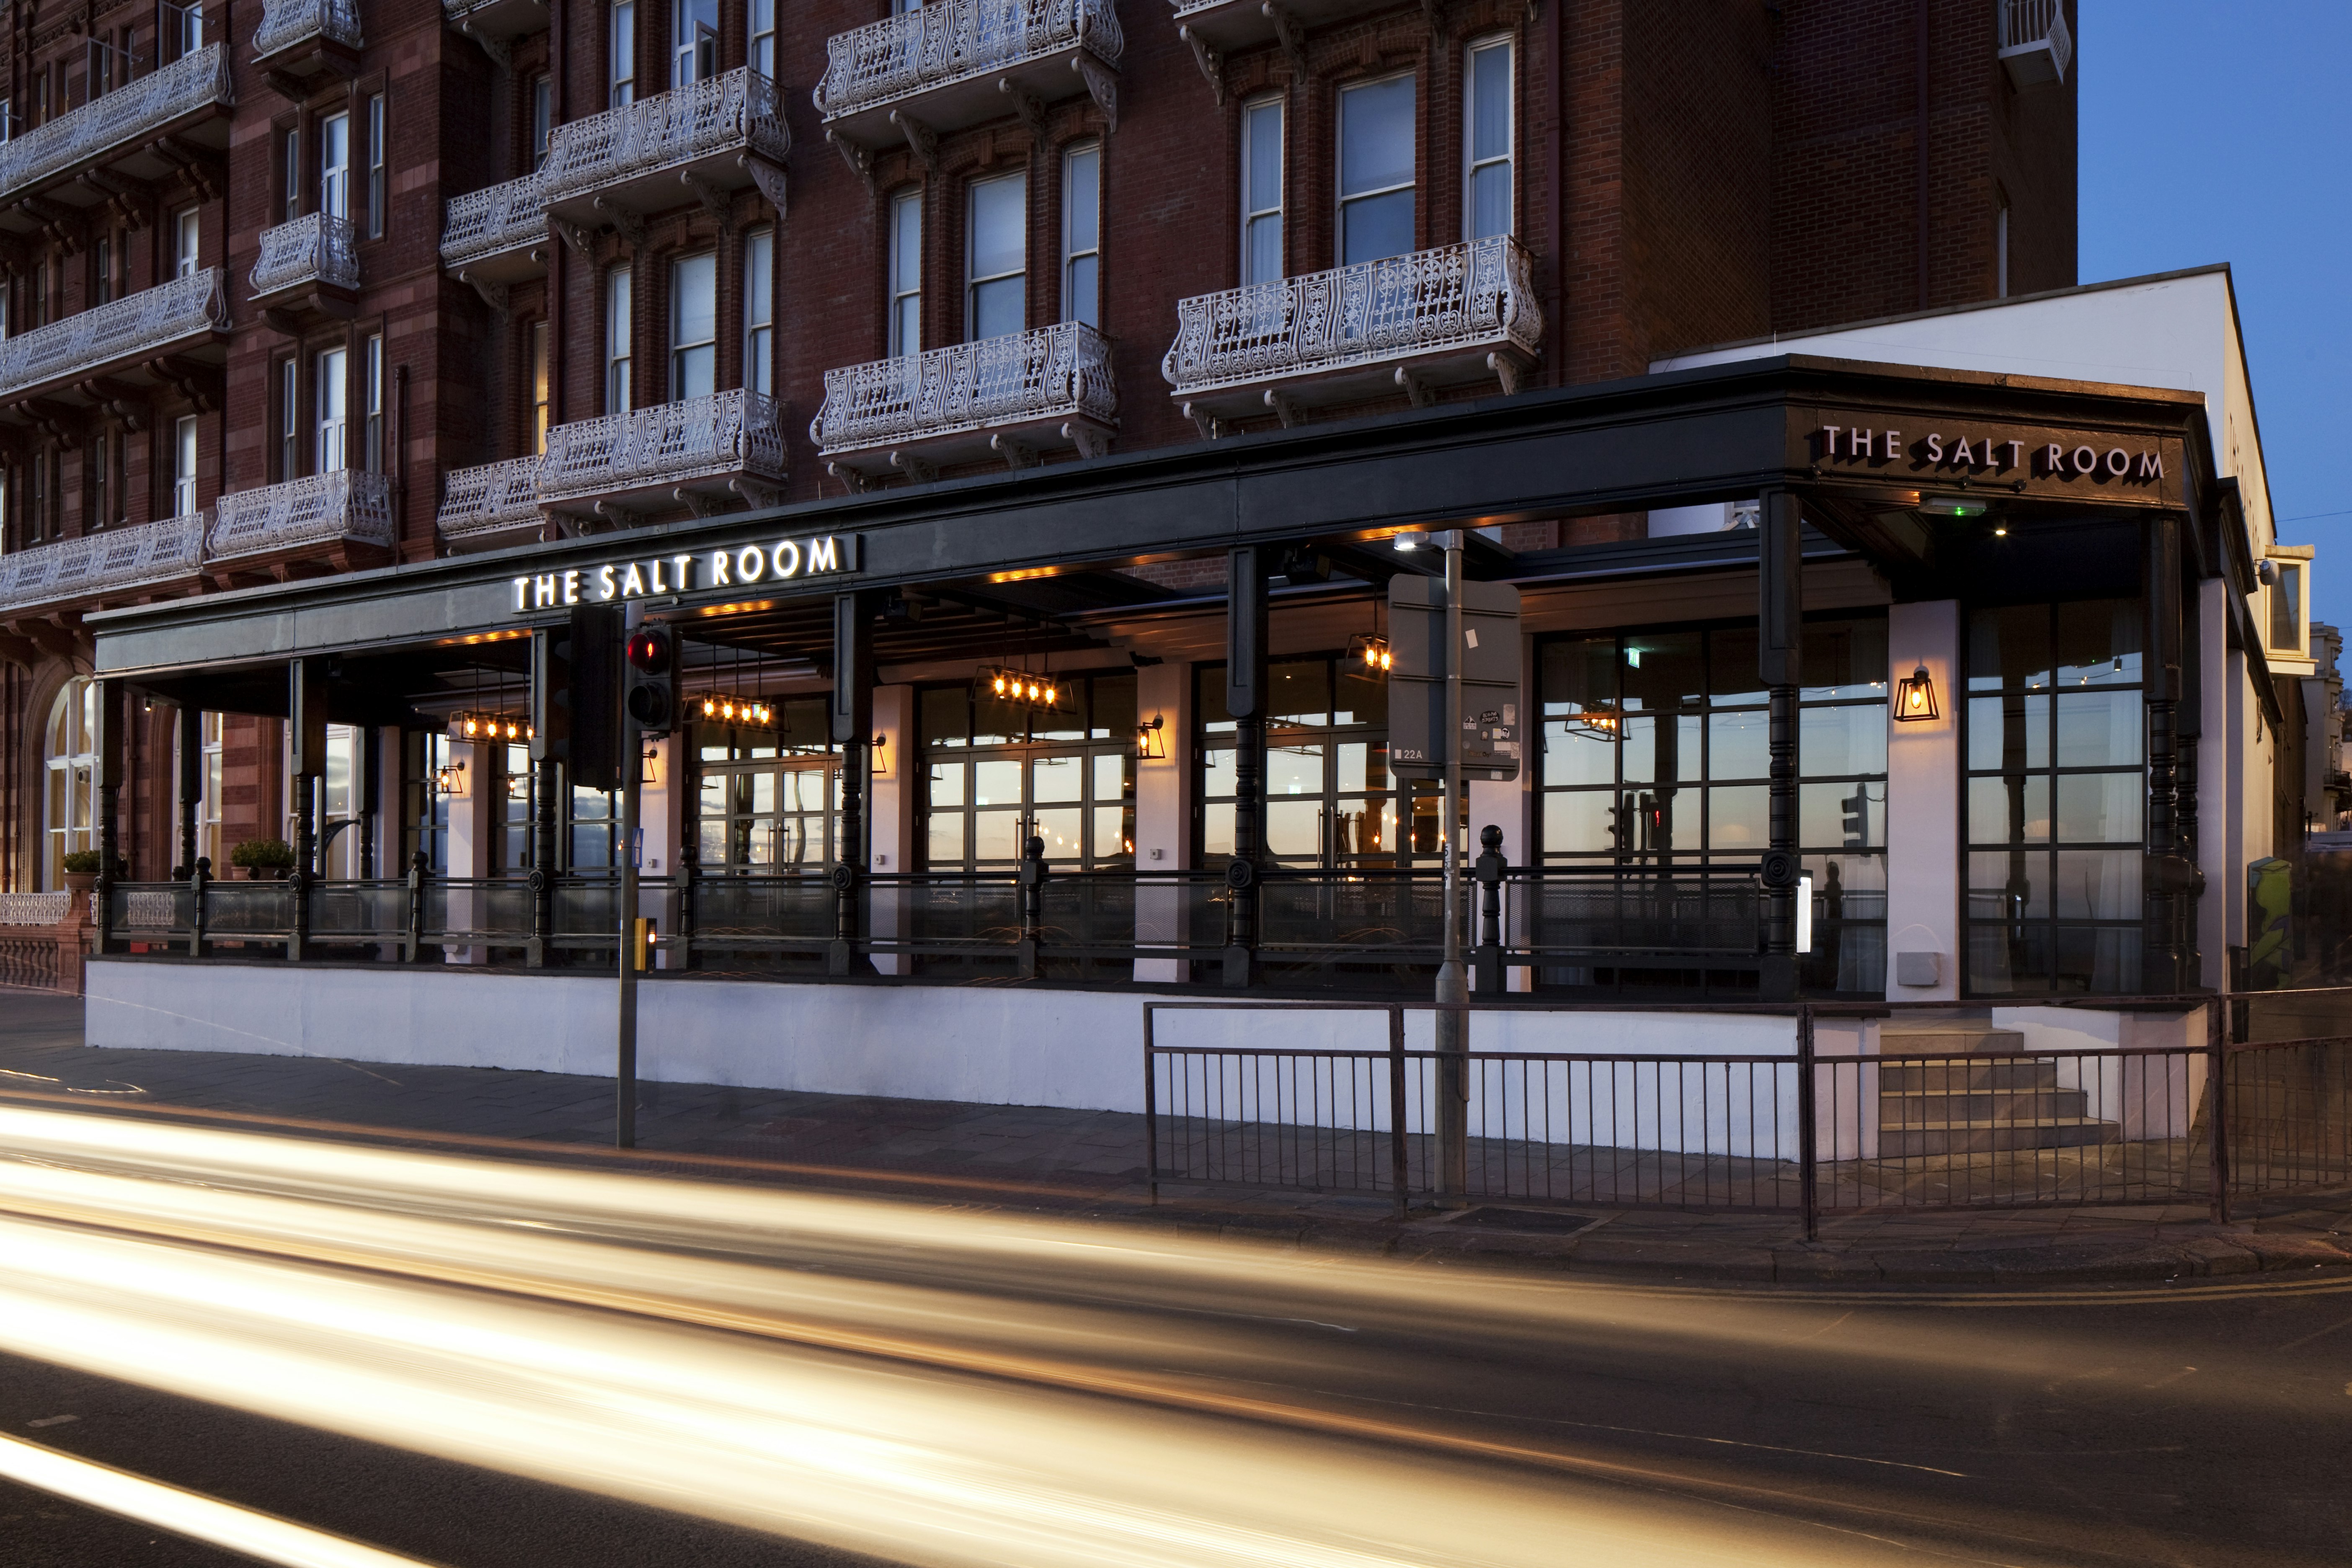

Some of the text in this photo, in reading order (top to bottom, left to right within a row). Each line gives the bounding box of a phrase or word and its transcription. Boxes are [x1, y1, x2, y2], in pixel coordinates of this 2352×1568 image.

[1823, 425, 2164, 479] THE SALT ROOM
[514, 536, 837, 610] THE SALT ROOM
[1404, 750, 1423, 759] 22A
